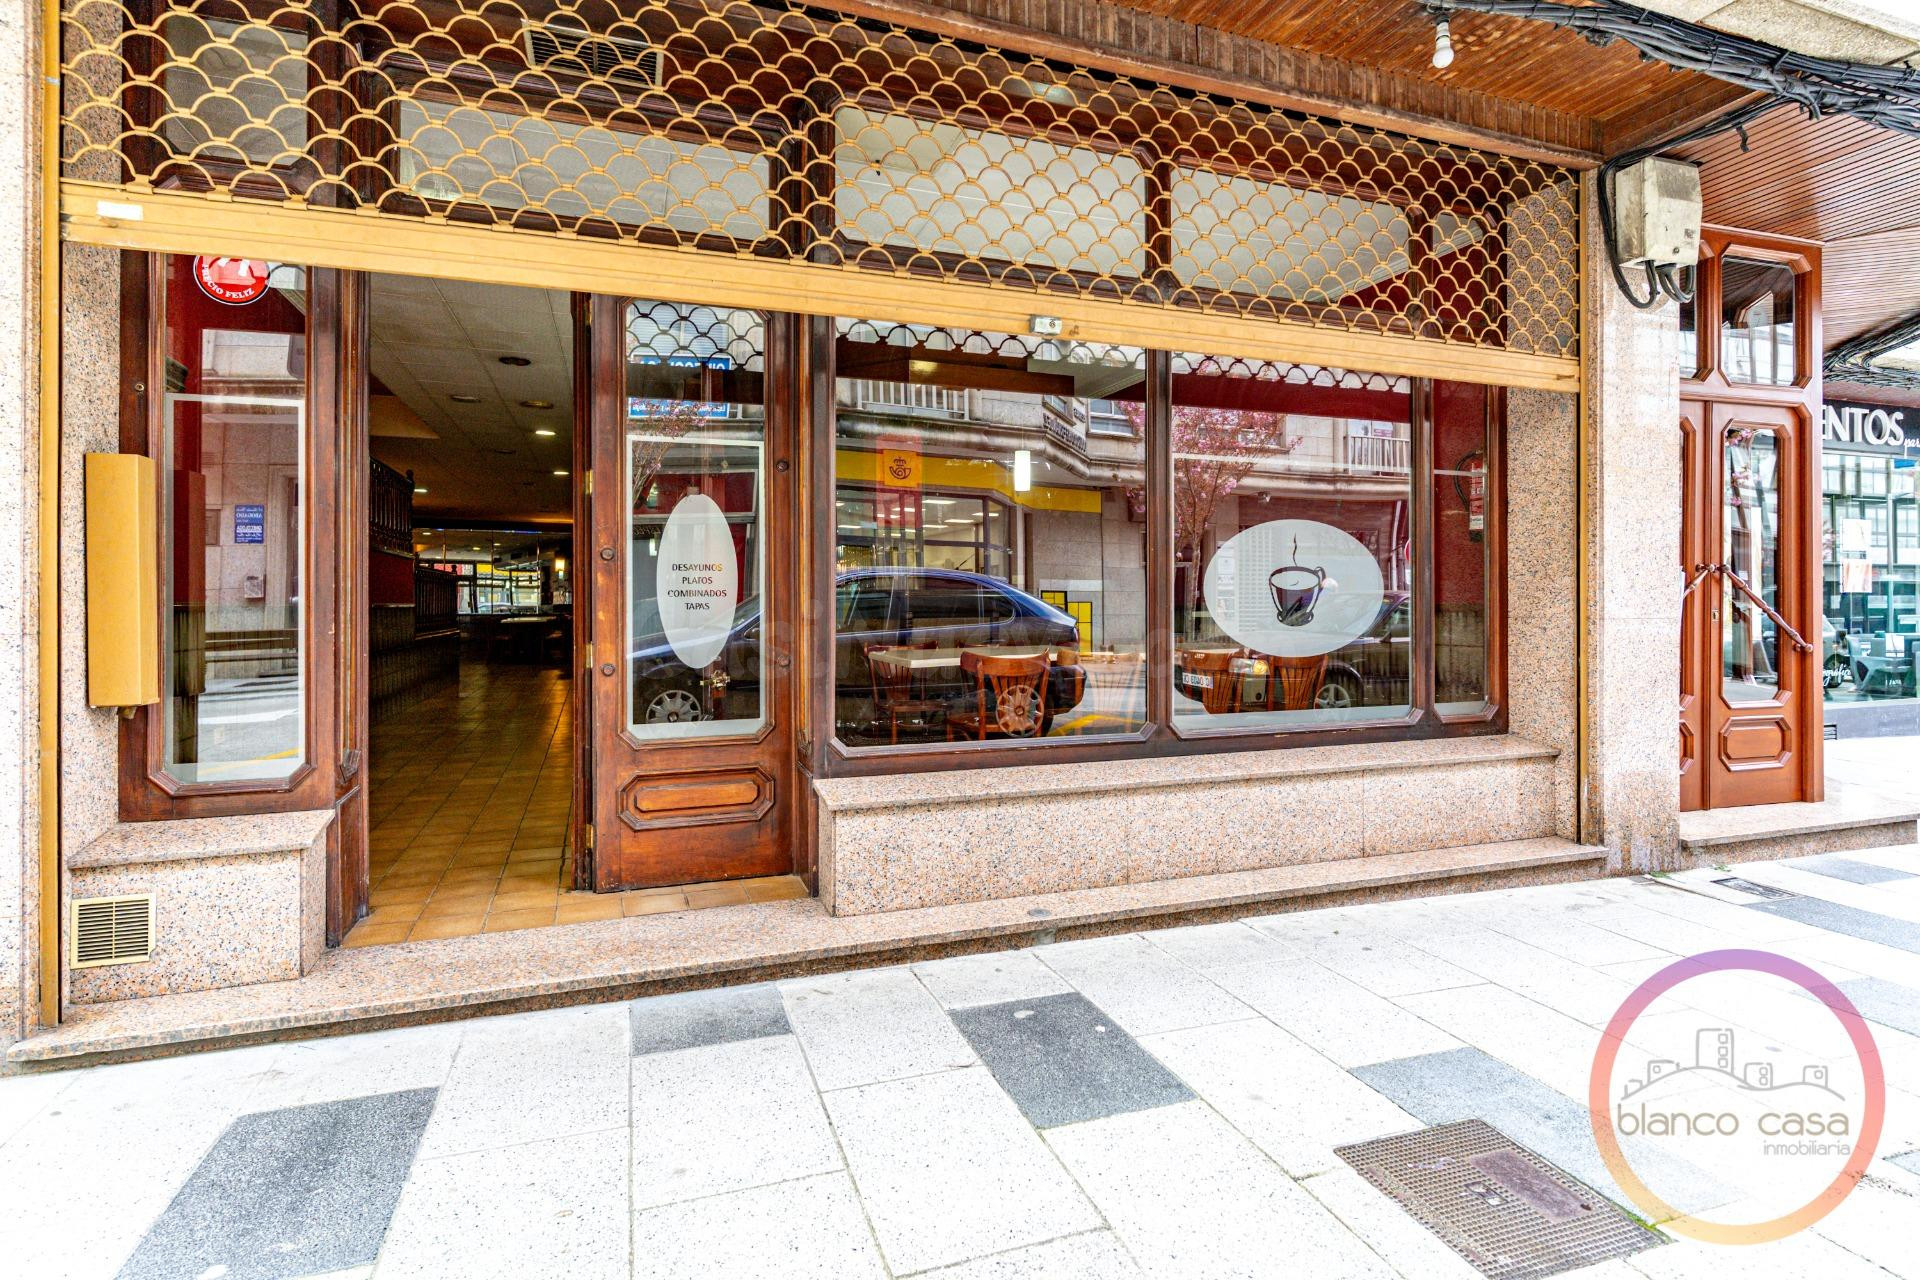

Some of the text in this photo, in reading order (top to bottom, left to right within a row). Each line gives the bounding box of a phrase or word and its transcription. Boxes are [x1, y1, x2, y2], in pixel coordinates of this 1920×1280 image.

[225, 287, 255, 298] FELIZ
[672, 563, 723, 572] DESAYUNOS
[682, 576, 713, 585] PLATOS
[667, 589, 727, 597] COMBINADOS
[685, 602, 710, 610] TAPAS
